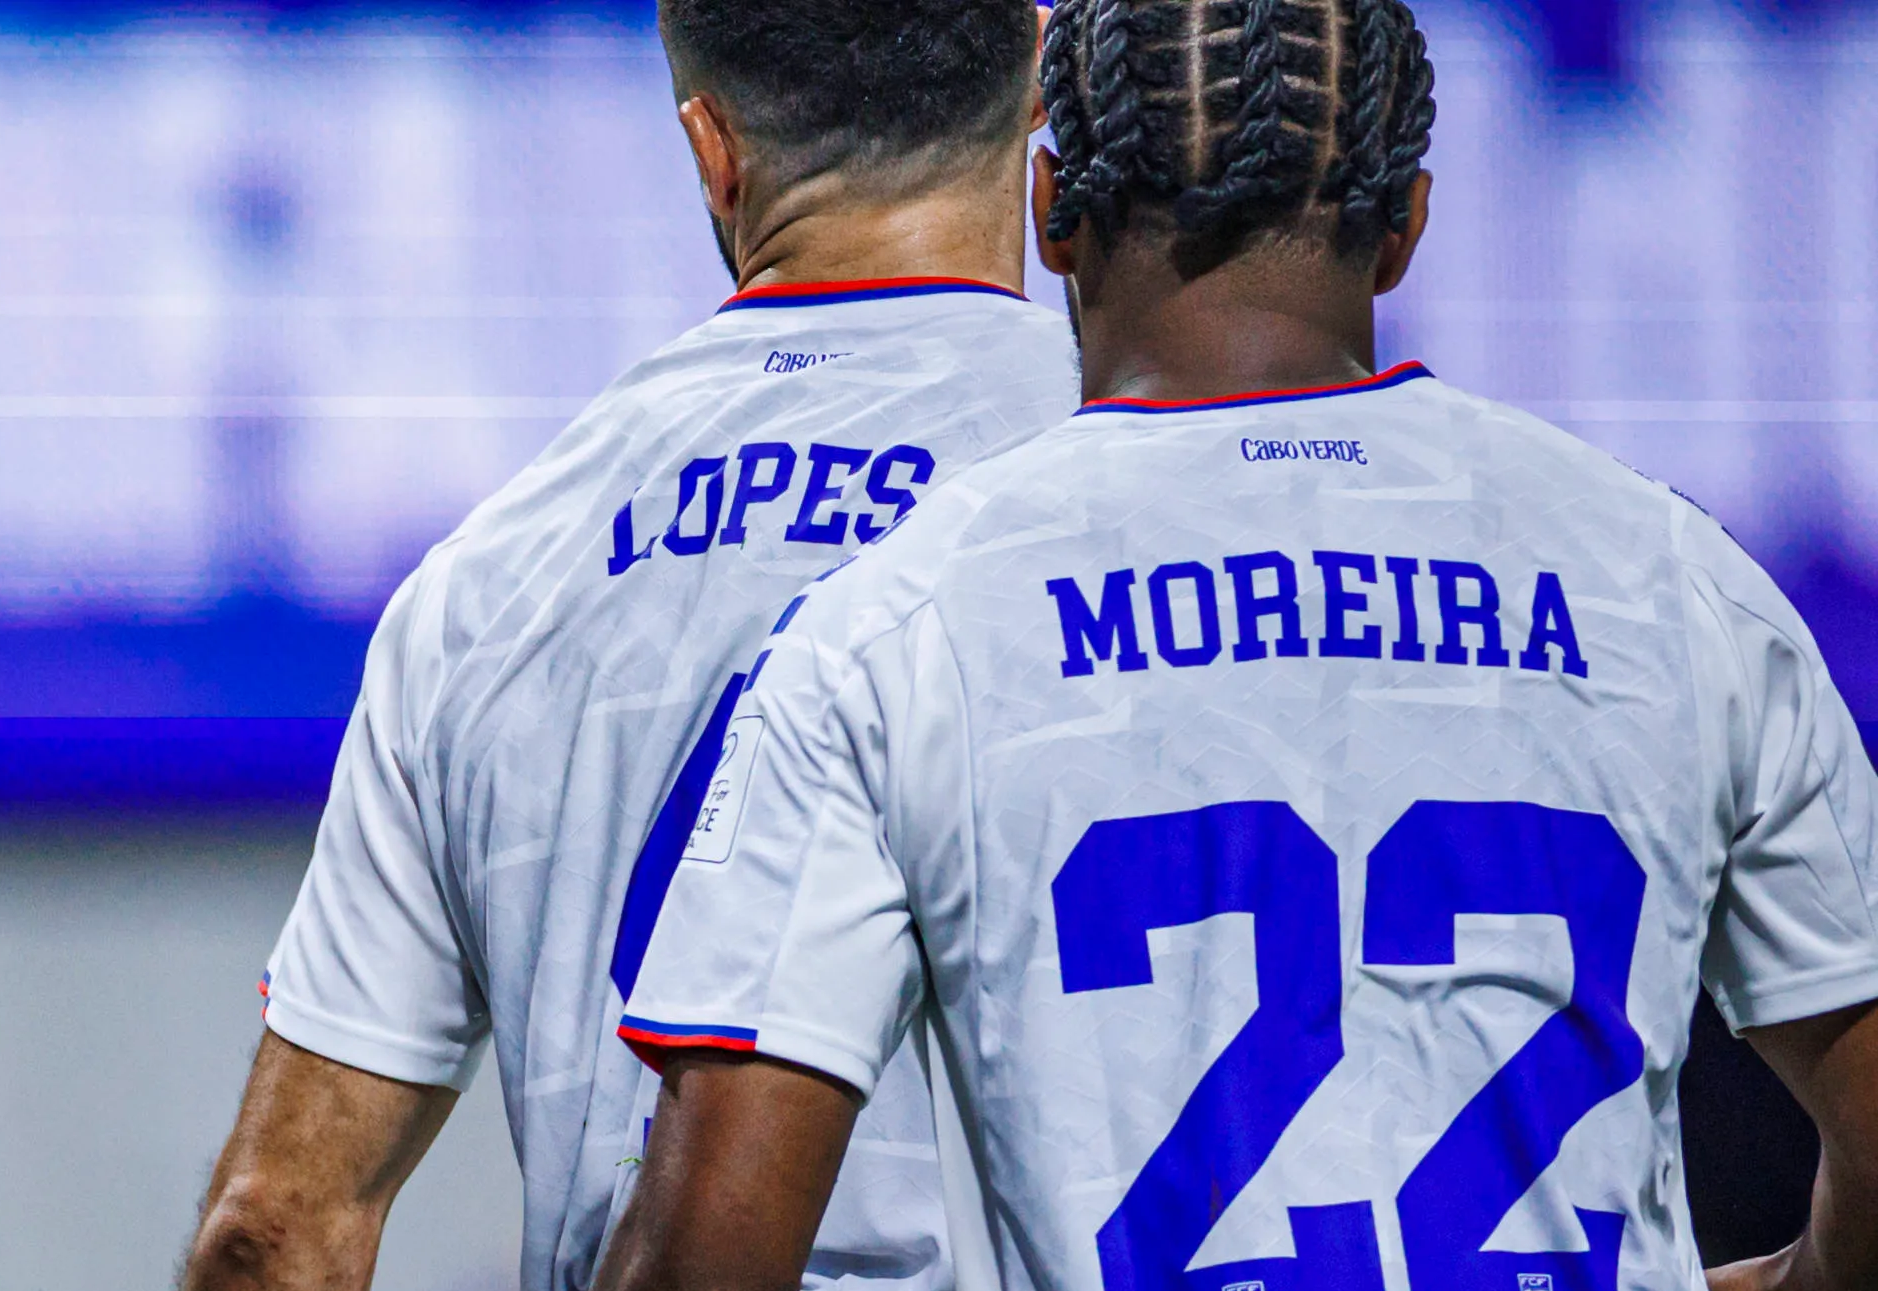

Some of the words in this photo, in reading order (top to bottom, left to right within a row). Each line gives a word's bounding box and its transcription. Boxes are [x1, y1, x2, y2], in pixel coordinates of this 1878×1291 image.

[607, 442, 936, 577] LOPES
[1299, 440, 1367, 465] VERDE
[1046, 551, 1588, 679] MOREIRA
